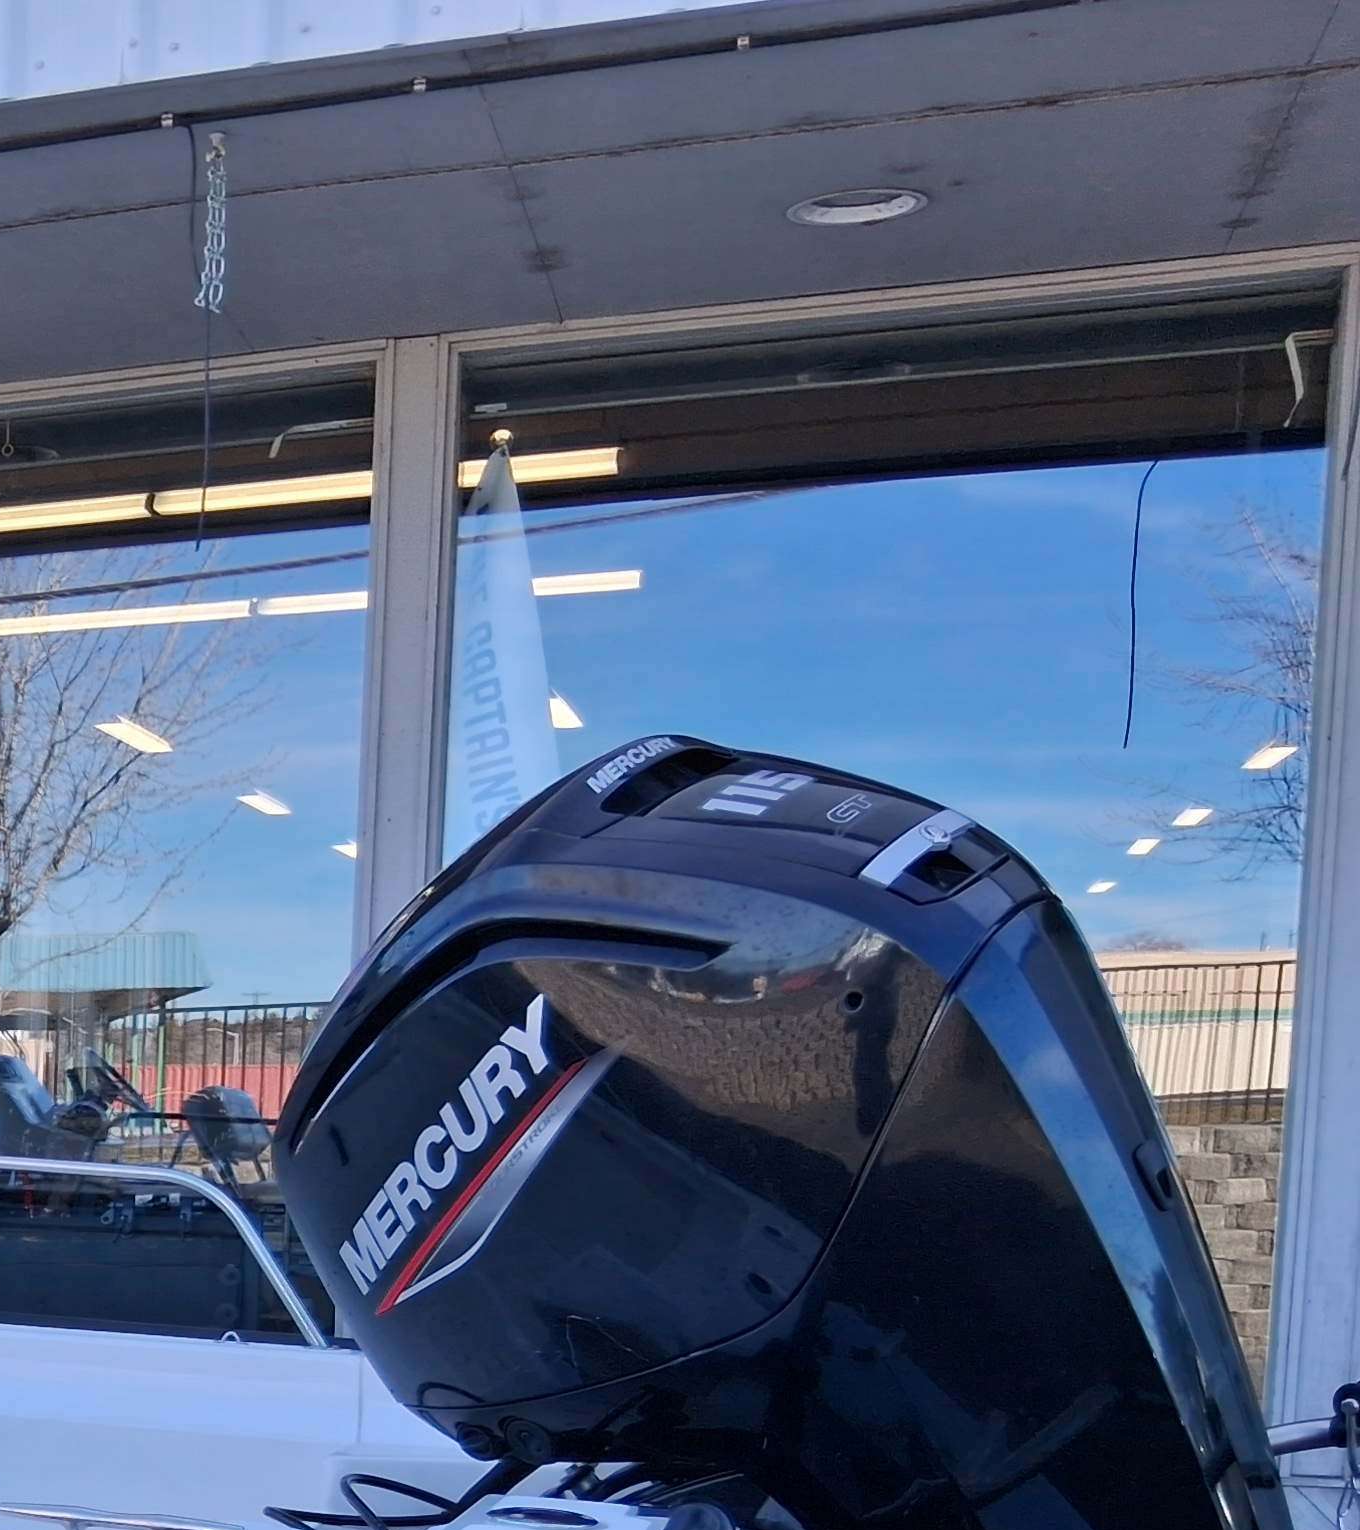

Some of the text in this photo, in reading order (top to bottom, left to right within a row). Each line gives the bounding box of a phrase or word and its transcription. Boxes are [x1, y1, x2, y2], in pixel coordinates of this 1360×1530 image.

[586, 736, 678, 794] MERCURY
[701, 769, 815, 816] 115
[339, 993, 549, 1296] MERCURY
